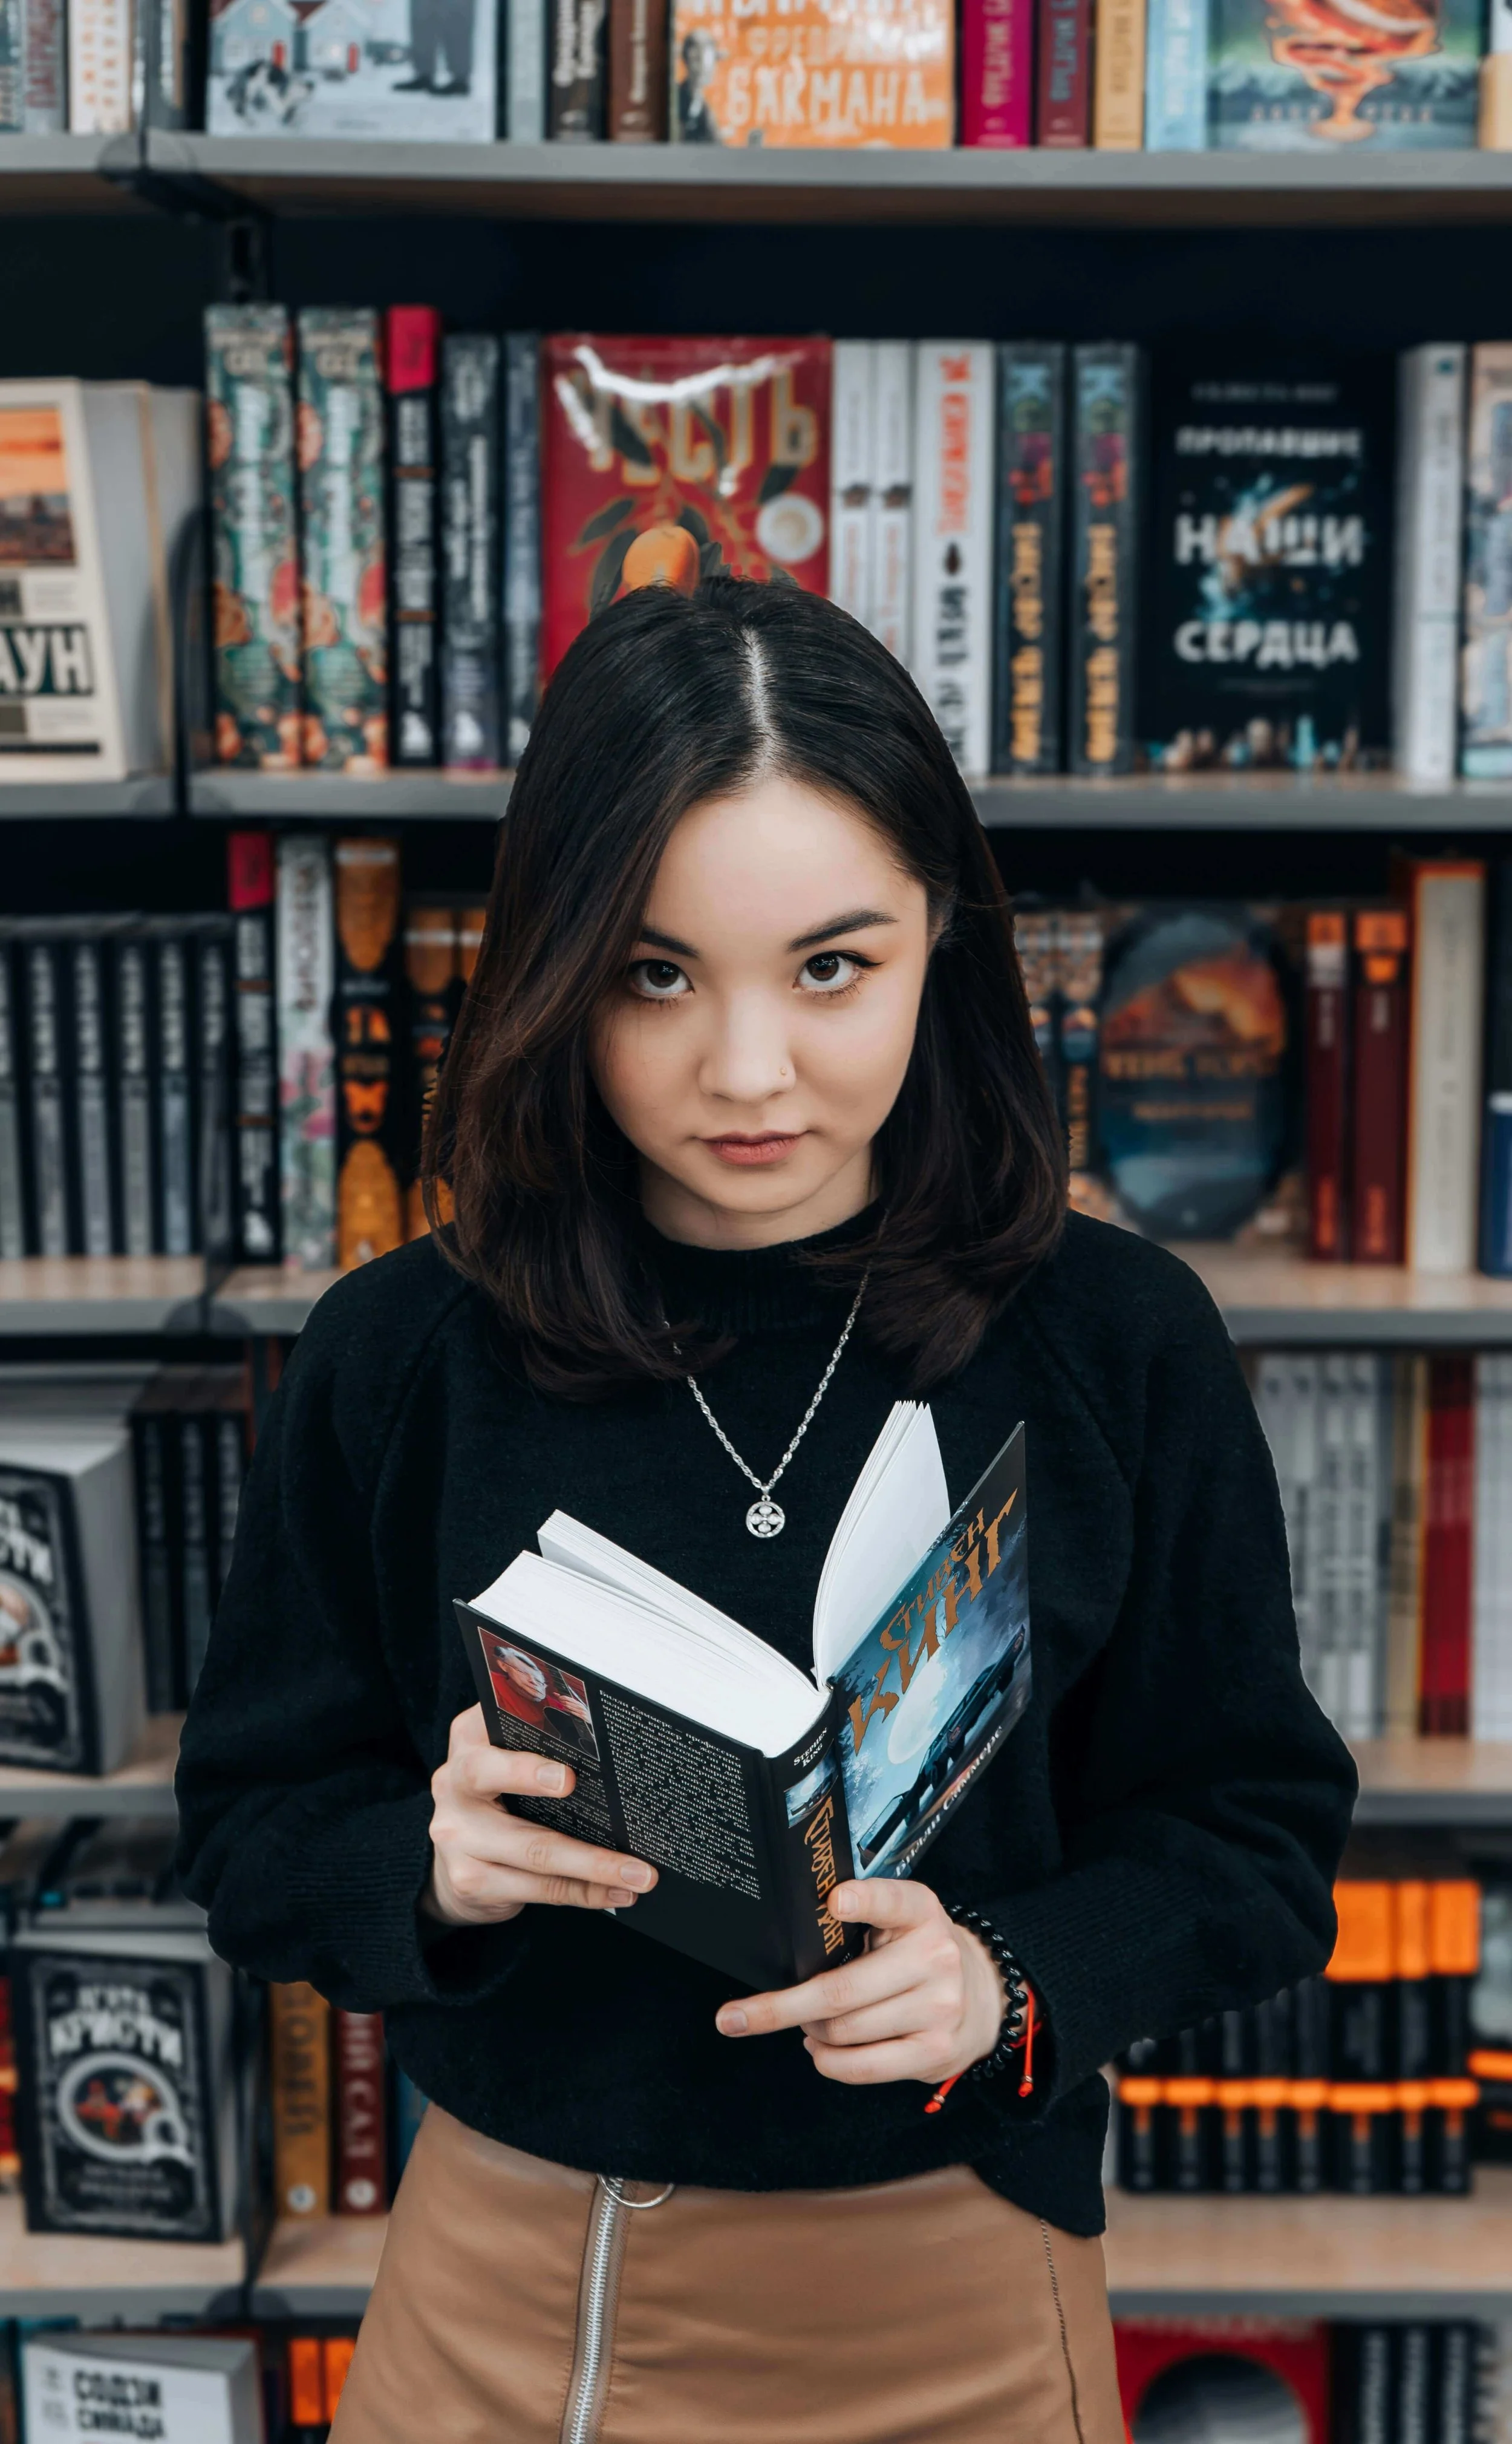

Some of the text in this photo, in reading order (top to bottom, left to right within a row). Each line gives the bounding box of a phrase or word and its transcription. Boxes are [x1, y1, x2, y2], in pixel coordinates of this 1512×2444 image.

[728, 64, 928, 126] БАКМАНА
[1176, 426, 1362, 455] ПРОПАВШИЕ
[1175, 514, 1363, 564] НАШИ
[1175, 620, 1358, 667] СЕРДЦА
[879, 1507, 985, 1652] СТИВЕН
[849, 1488, 1017, 1757] КИНГ
[793, 1727, 828, 1766] STEPHEN
[802, 1743, 824, 1768] KING
[804, 1795, 836, 1898] СТИВЕН
